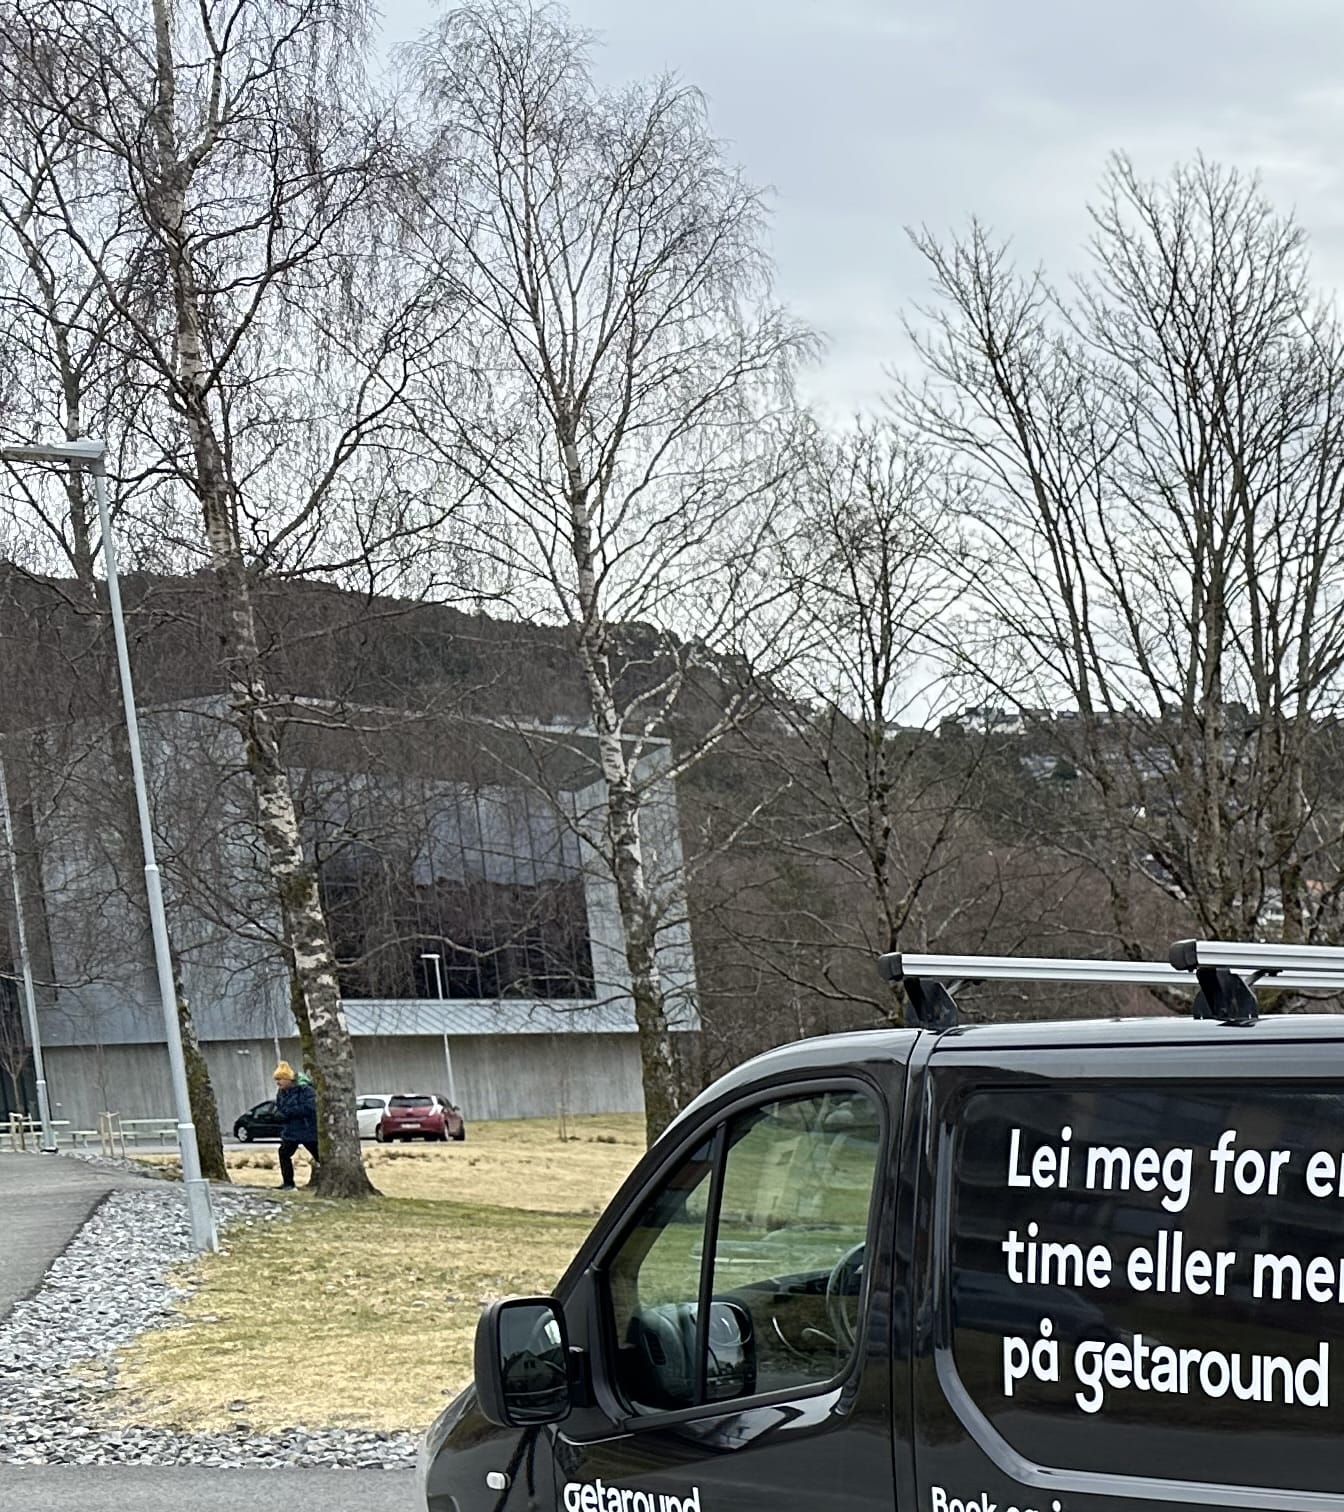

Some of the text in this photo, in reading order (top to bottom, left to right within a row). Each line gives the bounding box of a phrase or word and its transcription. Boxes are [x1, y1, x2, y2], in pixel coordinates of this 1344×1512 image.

[1007, 1126, 1073, 1188] Lei
[1085, 1146, 1193, 1213] meg
[1209, 1129, 1291, 1195] for
[1001, 1221, 1112, 1289] time
[1127, 1230, 1236, 1296] eller
[1003, 1317, 1330, 1414] på getaround
